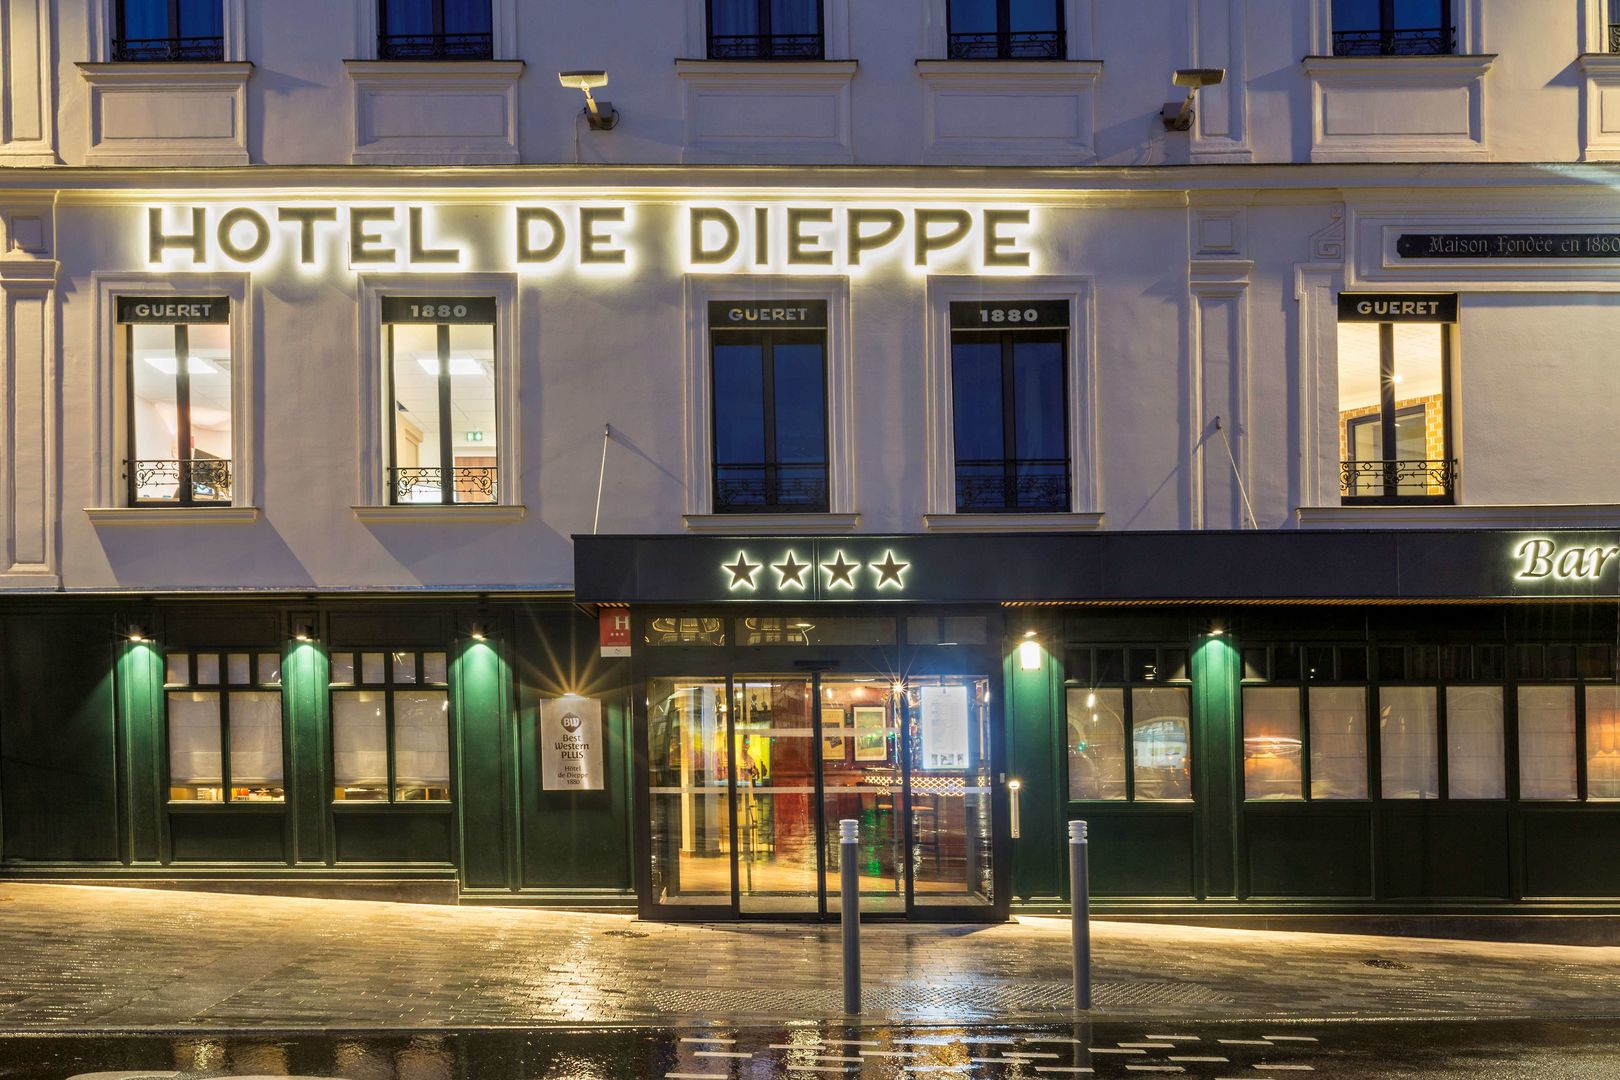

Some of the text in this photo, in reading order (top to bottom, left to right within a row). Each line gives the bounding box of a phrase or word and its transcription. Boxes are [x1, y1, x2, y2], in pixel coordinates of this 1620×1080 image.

[148, 206, 1031, 267] HOTEL DE DIEPPE
[1429, 235, 1488, 253] Maison
[1561, 238, 1580, 252] en
[1586, 235, 1620, 252] 1880
[135, 304, 212, 317] GUERET
[410, 304, 468, 318] 1880
[728, 308, 808, 321] GUERET
[1356, 301, 1440, 315] GUERET
[979, 309, 1039, 322] 1880
[1518, 539, 1619, 577] Bar
[615, 616, 629, 630] H
[563, 717, 580, 728] BW
[562, 734, 581, 742] Best
[554, 742, 590, 750] Western
[561, 751, 584, 759] PLUS
